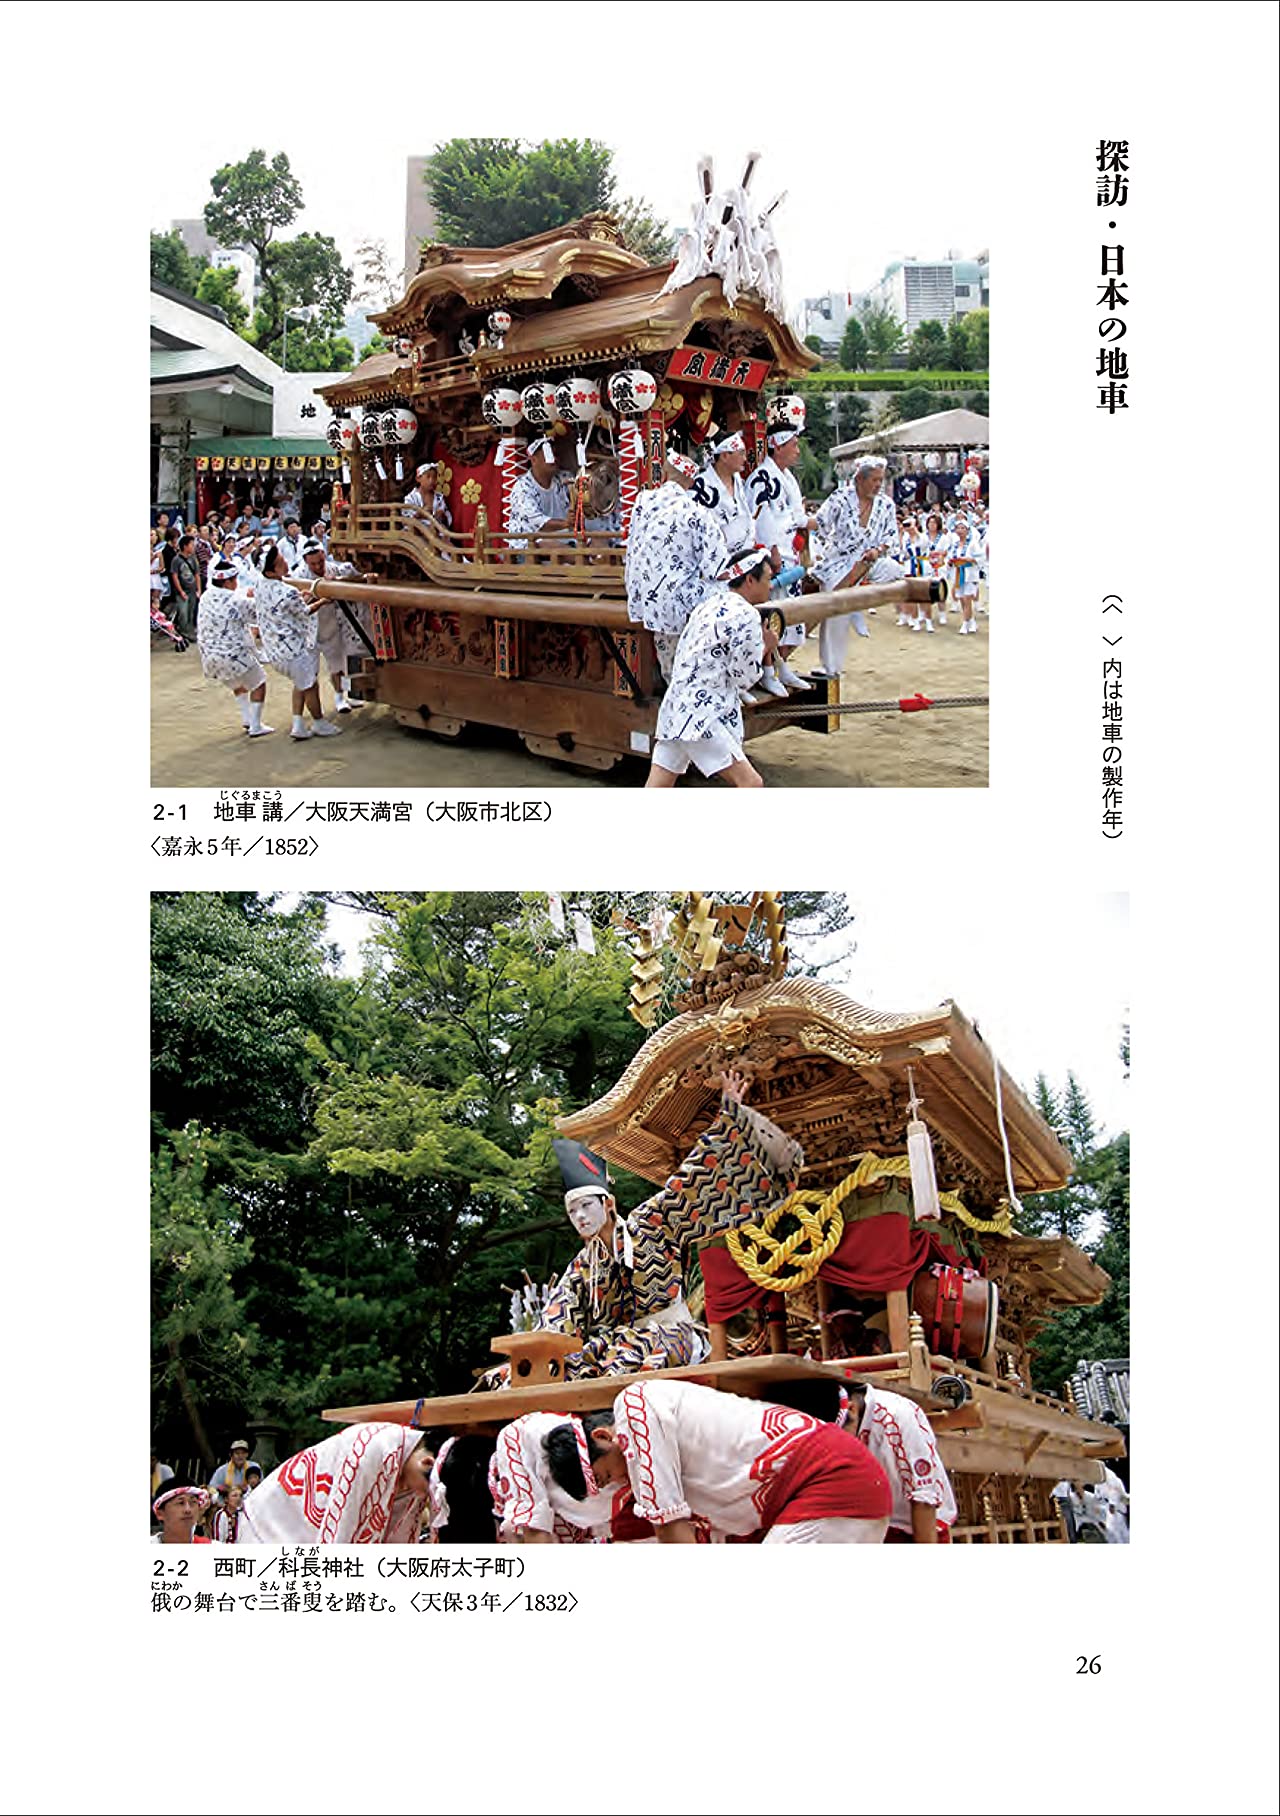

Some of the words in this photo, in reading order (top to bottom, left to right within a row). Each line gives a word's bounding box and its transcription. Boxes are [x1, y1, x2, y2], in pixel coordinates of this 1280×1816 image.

[1096, 139, 1129, 414] 探訪・日本の地車
[153, 803, 186, 821] 2-1
[281, 1546, 320, 1556] しなが
[153, 1559, 189, 1577] 2-2
[150, 1580, 183, 1591] にわか
[1075, 1654, 1102, 1675] 26
